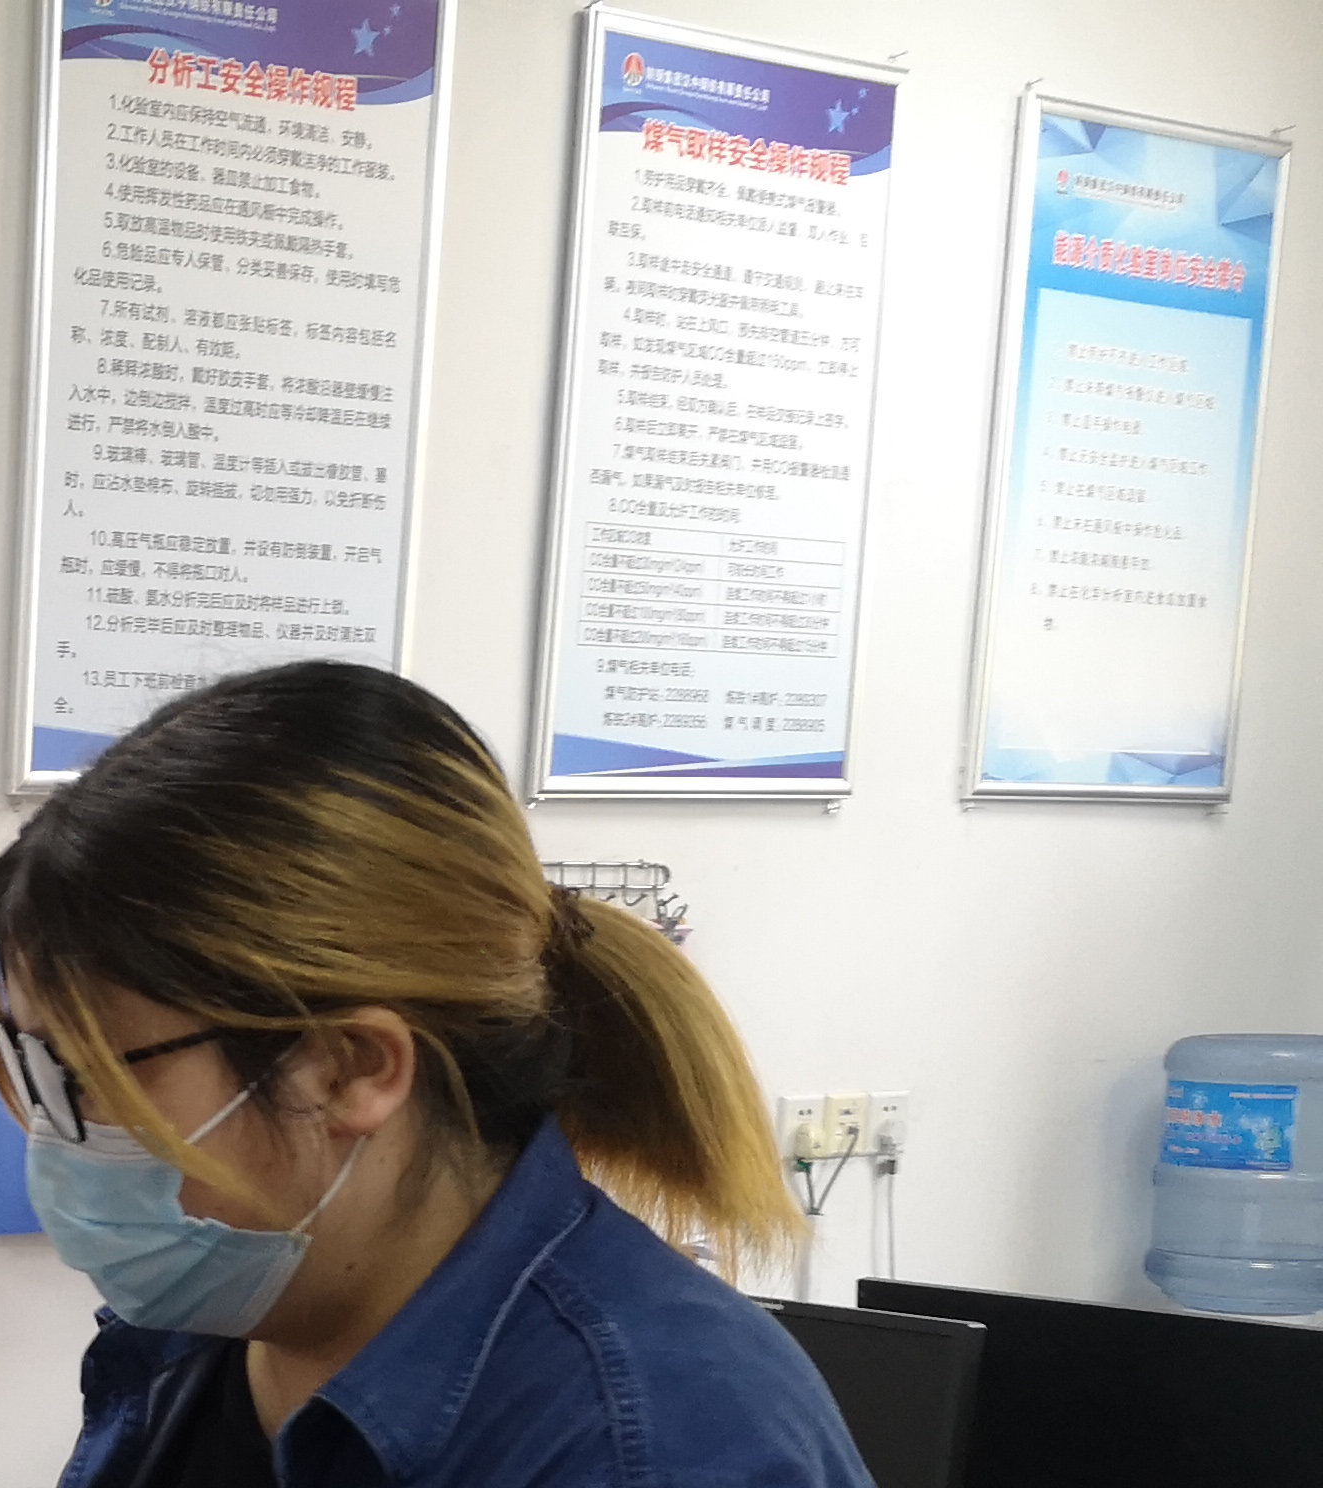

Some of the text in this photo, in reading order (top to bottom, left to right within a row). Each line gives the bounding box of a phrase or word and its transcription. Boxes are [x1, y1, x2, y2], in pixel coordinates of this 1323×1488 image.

[147, 47, 358, 112] 分析工安全操作规程
[642, 118, 851, 185] 煤气取样安全操作规程
